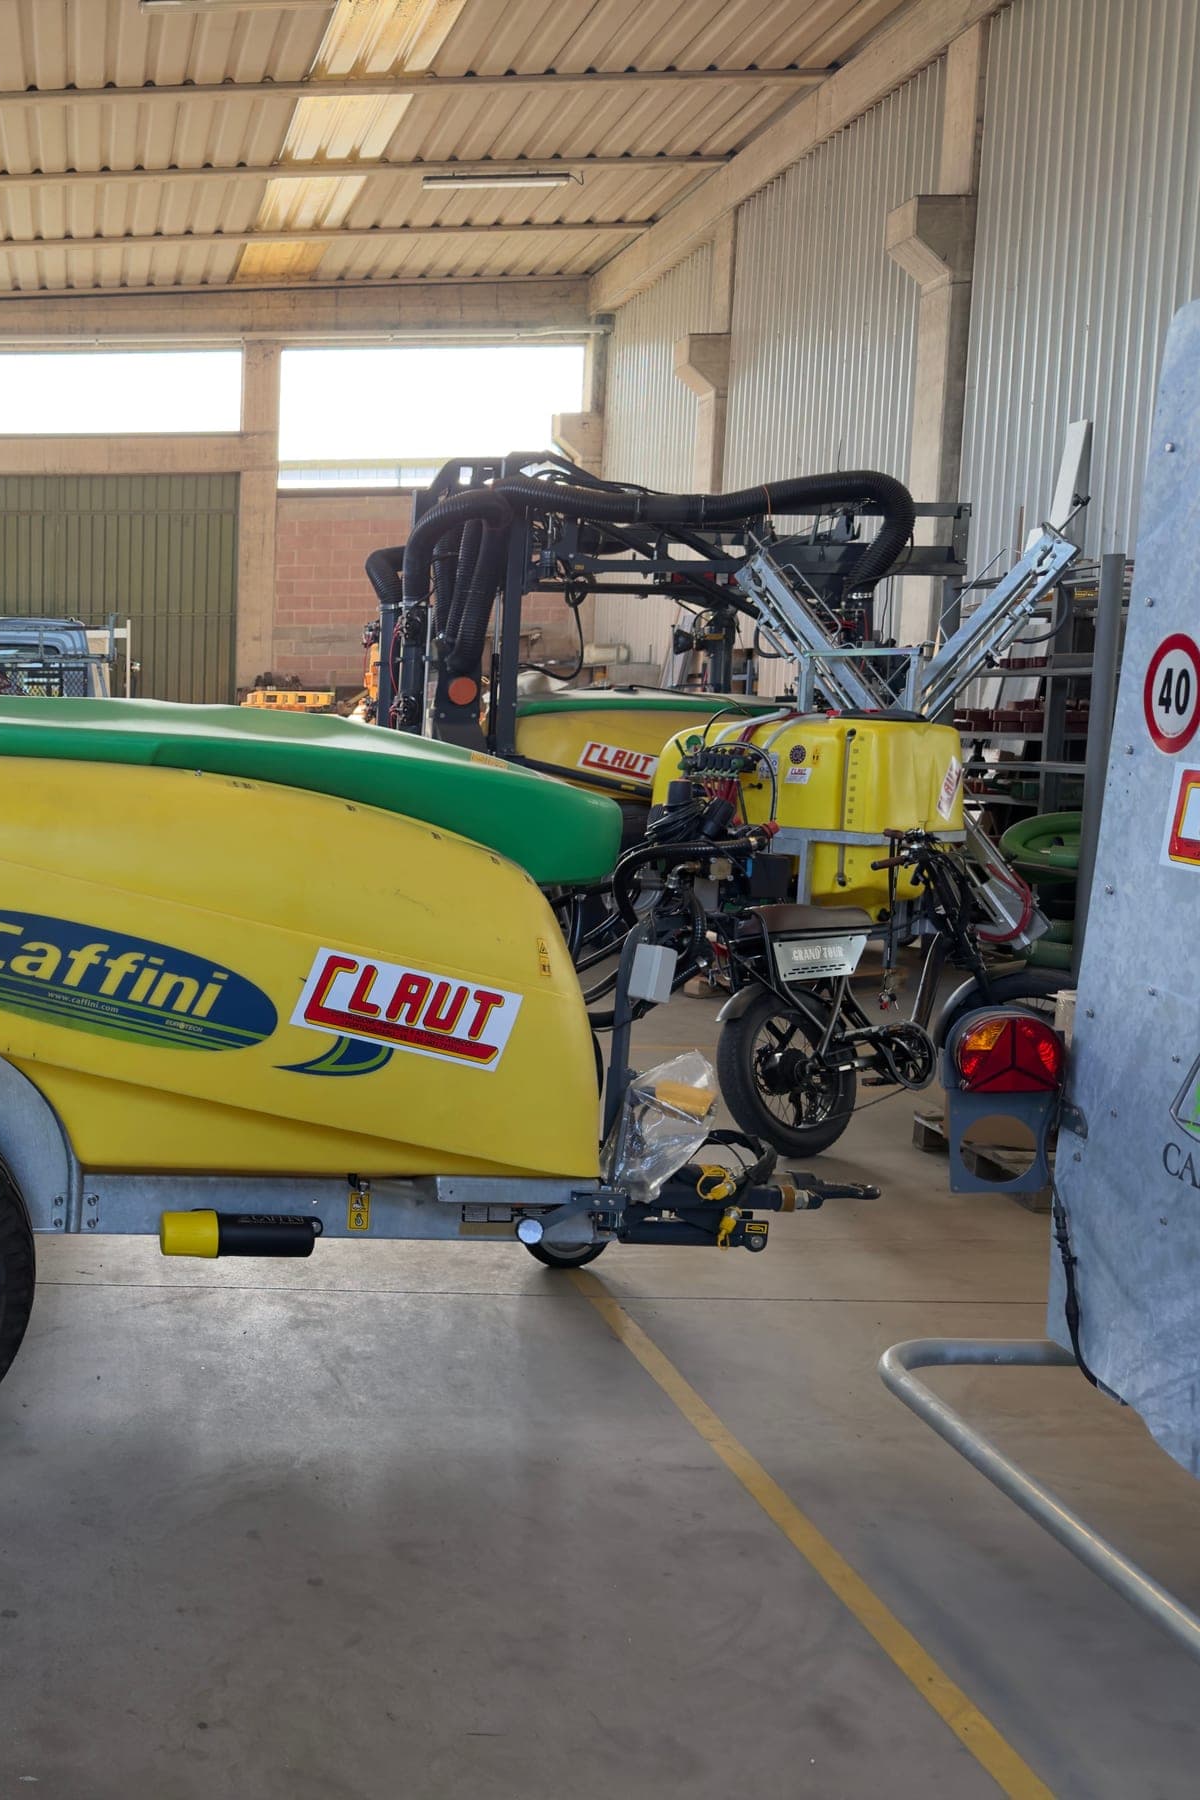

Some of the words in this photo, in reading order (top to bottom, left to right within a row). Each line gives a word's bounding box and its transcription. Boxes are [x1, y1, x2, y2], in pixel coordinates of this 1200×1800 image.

[1158, 667, 1190, 715] 40
[582, 743, 654, 780] CLAUT
[822, 946, 844, 959] TOUR
[47, 991, 120, 1014] www.caffini.com
[304, 955, 505, 1064] CLAUT
[1163, 1142, 1200, 1189] CA
